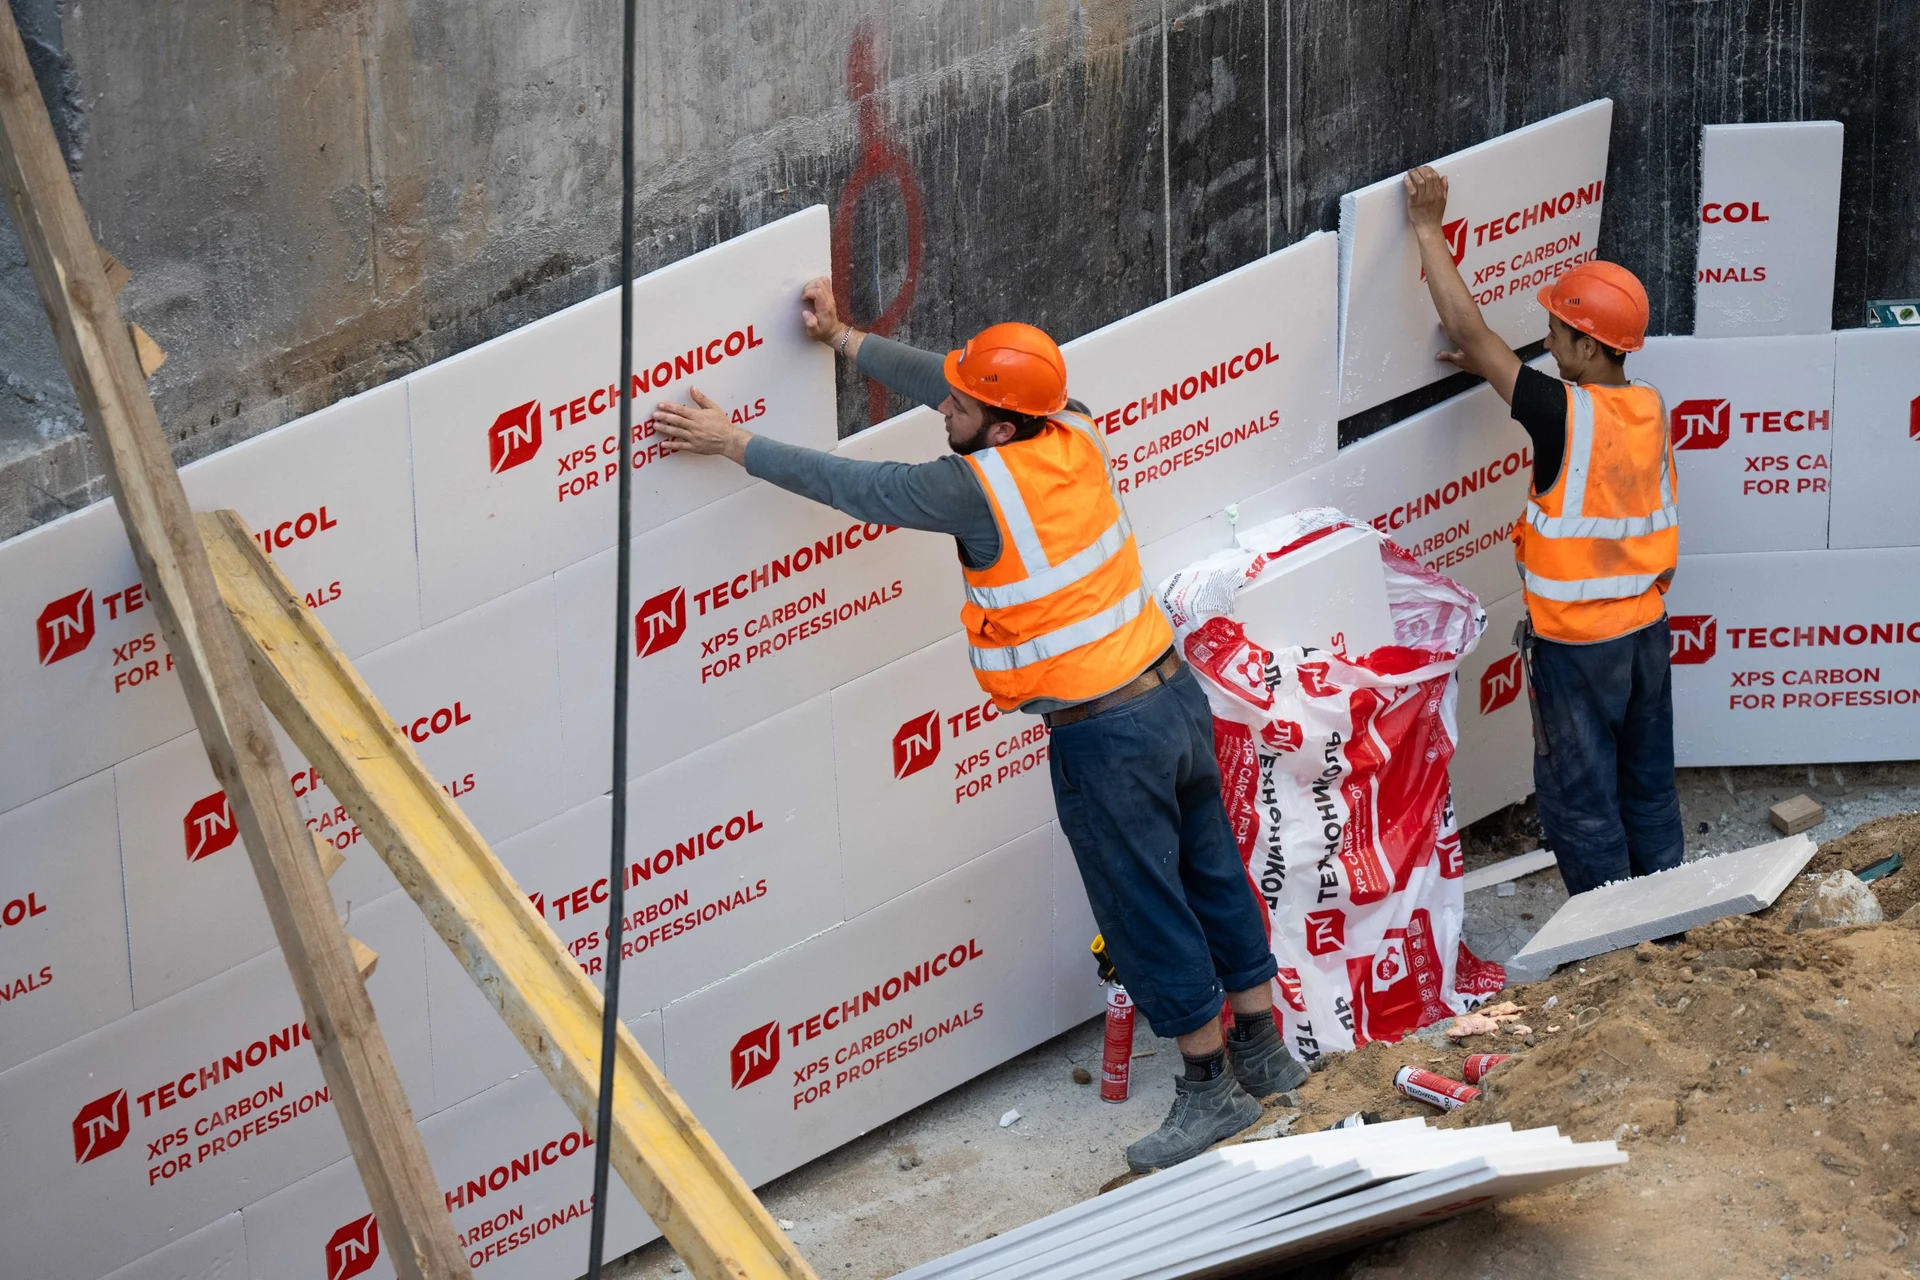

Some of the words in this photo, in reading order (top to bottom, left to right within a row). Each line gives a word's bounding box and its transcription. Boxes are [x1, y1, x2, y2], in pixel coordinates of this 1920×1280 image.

[1474, 180, 1603, 247] TECHNONI
[1472, 261, 1505, 287] XPS
[1510, 232, 1580, 271] CARBON
[1473, 285, 1504, 306] FOR
[1093, 341, 1279, 435] TECHNONICOL
[1133, 416, 1209, 463] CARBON
[1740, 410, 1829, 433] TECH
[557, 444, 597, 476] XPS
[1135, 410, 1280, 488] PROFESSIONALS
[1744, 455, 1789, 472] XPS
[1796, 454, 1828, 470] CA
[557, 470, 598, 503] FOR
[1743, 478, 1789, 496] FOR
[1797, 477, 1831, 493] PR
[1408, 519, 1470, 559] ARBON
[701, 627, 738, 659] XPS
[744, 588, 826, 637] CARBON
[701, 653, 741, 684] FOR
[746, 580, 903, 664] PROFESSIONALS
[112, 633, 156, 667] XPS
[114, 660, 159, 694] FOR
[1730, 671, 1775, 687] XPS
[1782, 667, 1880, 685] CARBON
[1729, 694, 1775, 710] FOR
[954, 749, 990, 780] XPS
[995, 723, 1051, 758] CARB
[1242, 738, 1254, 765] XPS
[955, 774, 992, 804] FOR
[1352, 867, 1368, 894] XPS
[0, 892, 47, 928] OL
[620, 879, 767, 960] ROFESSIONALS
[787, 938, 983, 1047] TECHNONICOL
[1382, 962, 1390, 978] XPS
[137, 1021, 312, 1118] TECHNONI
[793, 1057, 829, 1087] XPS
[834, 1014, 913, 1065] CARBON
[793, 1078, 830, 1111] FOR
[836, 1002, 984, 1089] PROFESSIONALS
[147, 1127, 188, 1161] XPS
[194, 1082, 284, 1137] CARBON
[149, 1153, 192, 1187] FOR
[198, 1086, 332, 1164] PROFESSION
[445, 1128, 596, 1213] HNONICOL
[469, 1193, 596, 1269] OFESSIONAL
